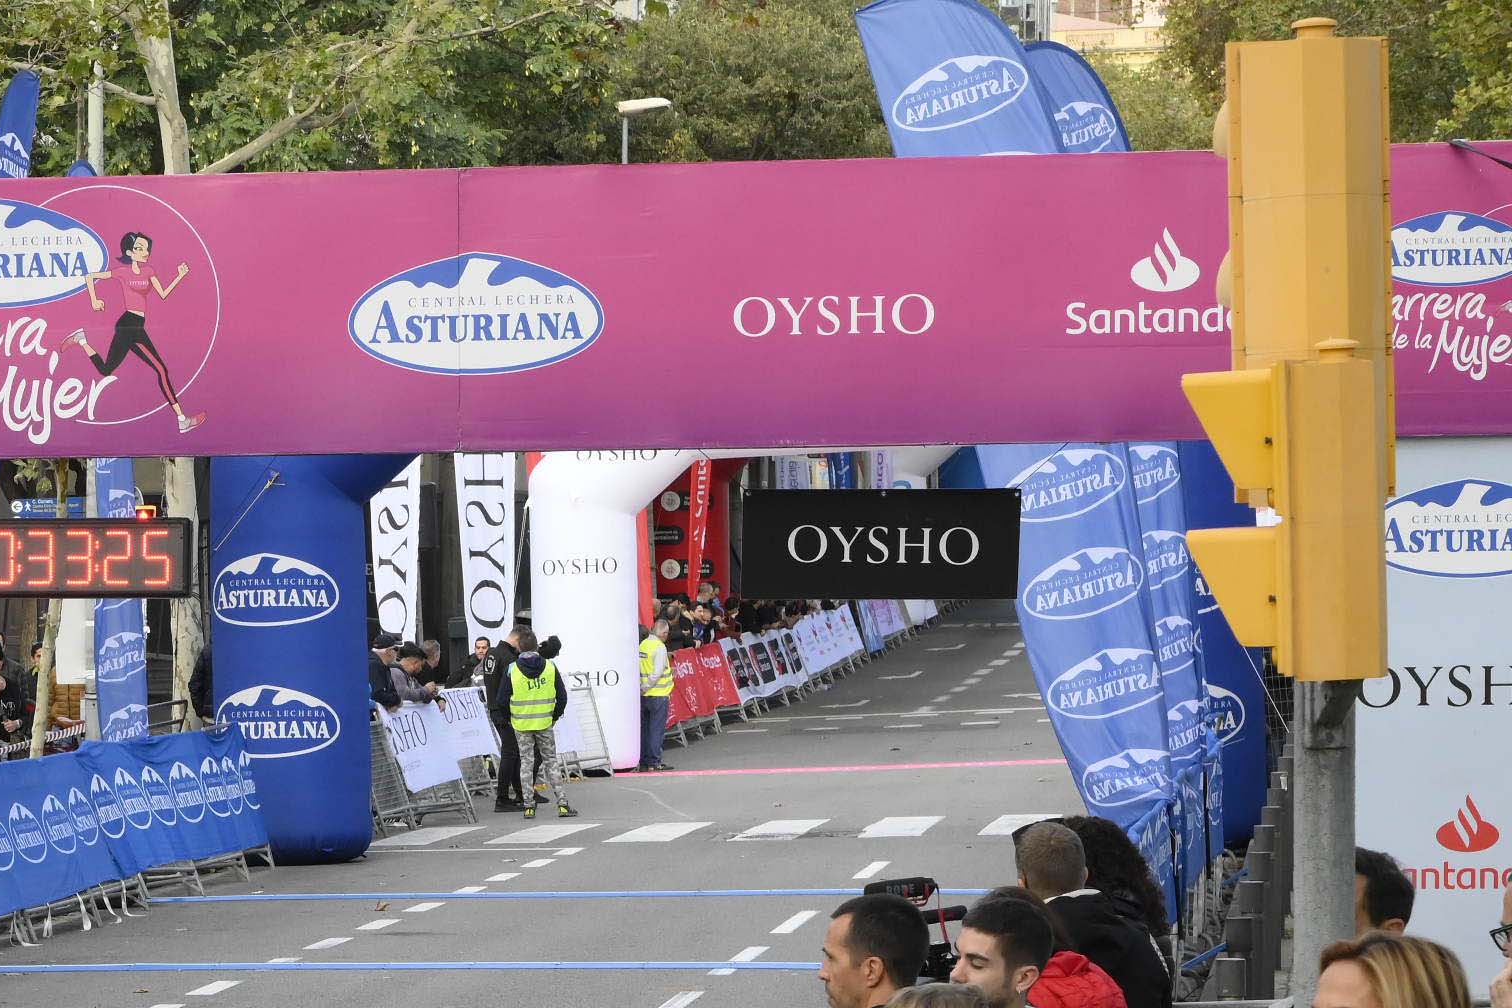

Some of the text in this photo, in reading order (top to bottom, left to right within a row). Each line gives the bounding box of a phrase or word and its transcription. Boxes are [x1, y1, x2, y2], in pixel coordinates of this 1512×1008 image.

[11, 235, 83, 246] LECHERA
[408, 293, 576, 308] CENTRAL LECHERA
[1392, 291, 1487, 321] arrera
[369, 300, 584, 344] ASTURIANA
[733, 293, 935, 337] OYSHO
[1065, 301, 1233, 335] Santand
[1414, 322, 1432, 349] la
[1427, 316, 1512, 381] Muje
[1411, 514, 1479, 525] CENTRAL
[787, 524, 980, 566] OYSHO
[1384, 517, 1512, 554] ASTURIA
[542, 557, 618, 576] OYSHO
[230, 578, 325, 587] CENTRAL LECHERA
[217, 583, 330, 610] ASTURIANA
[572, 670, 619, 688] SHO
[221, 713, 331, 740] TURIANA
[231, 709, 326, 718] CENTRAL LECHERA
